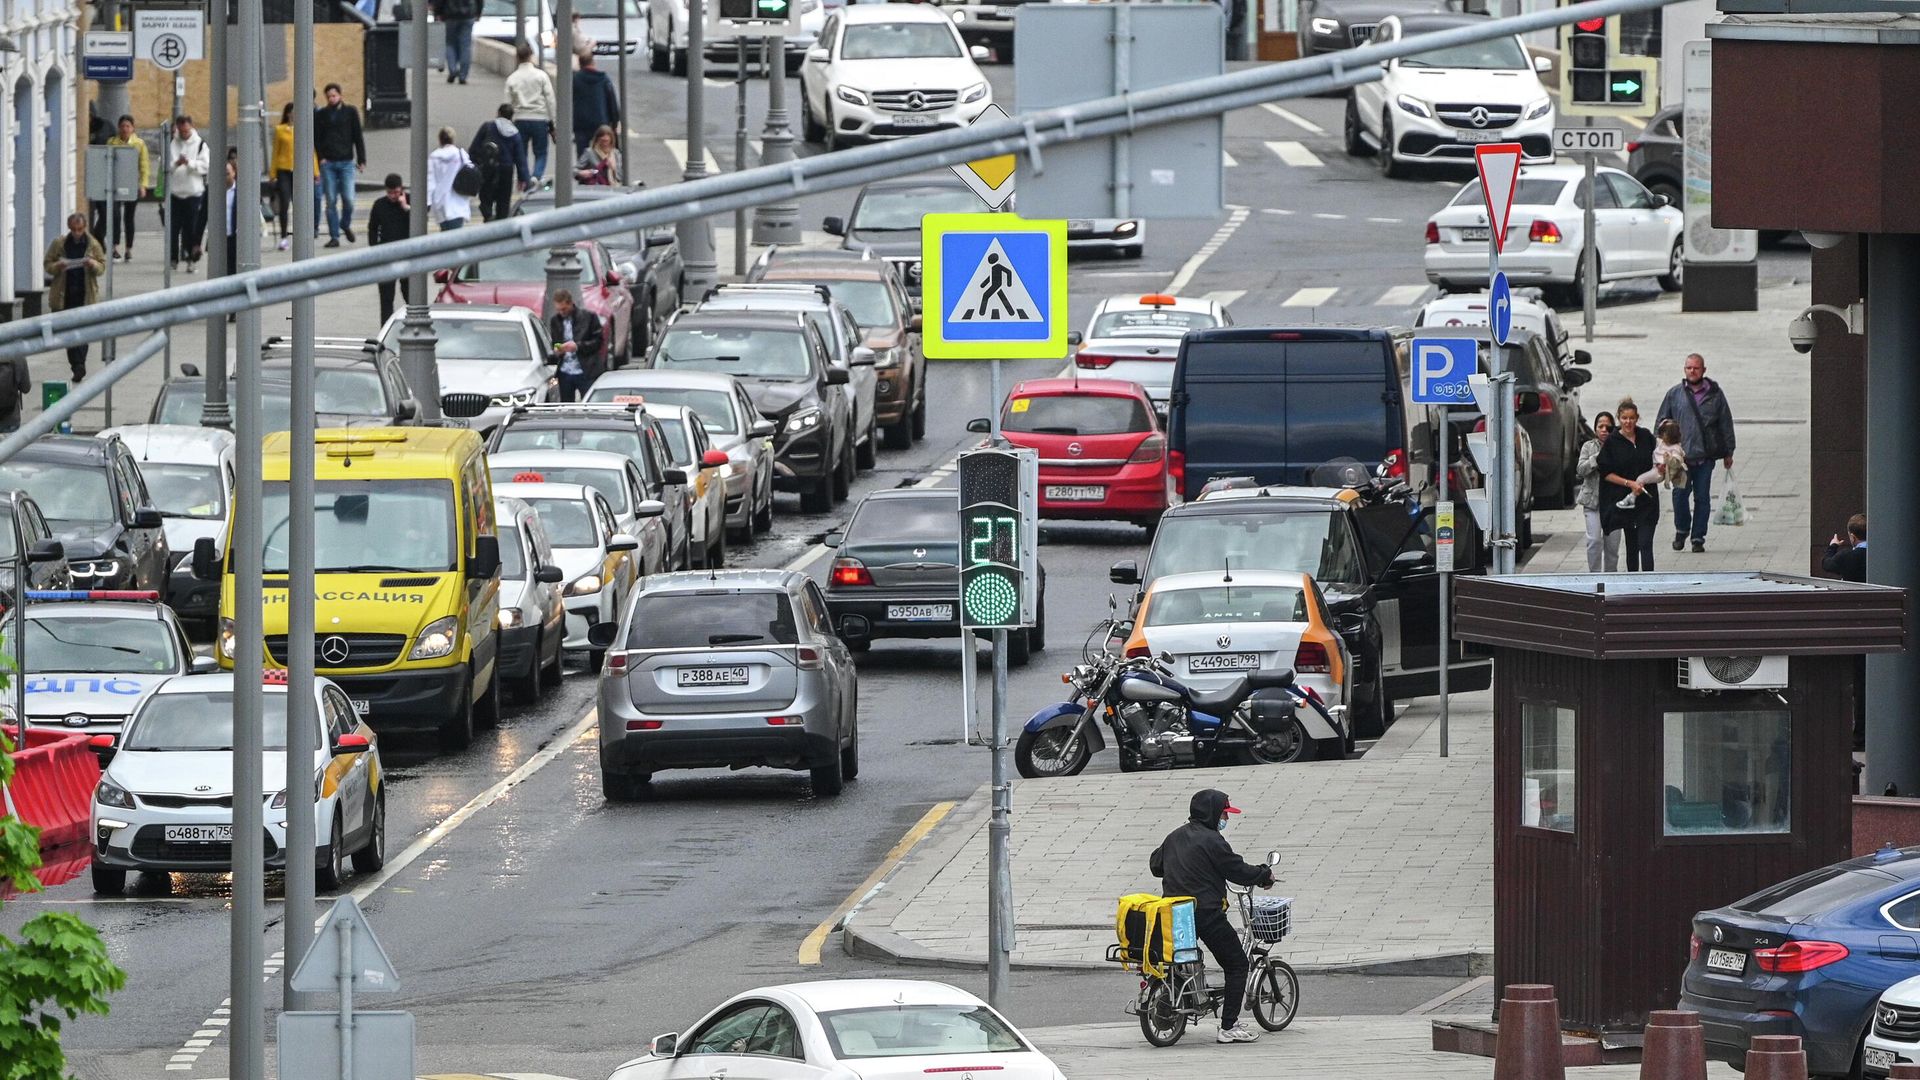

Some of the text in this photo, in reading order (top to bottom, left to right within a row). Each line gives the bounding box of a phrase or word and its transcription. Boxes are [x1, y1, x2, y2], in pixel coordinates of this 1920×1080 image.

[1562, 132, 1613, 147] СТОП
[1419, 345, 1454, 396] P
[1435, 384, 1470, 393] 10 15 20
[971, 517, 1016, 563] 27
[263, 591, 424, 604] НССАЦИЯ
[732, 667, 744, 677] 40
[25, 678, 141, 695] ДПС
[168, 827, 215, 839] О488ТК
[1755, 937, 1769, 945] X4
